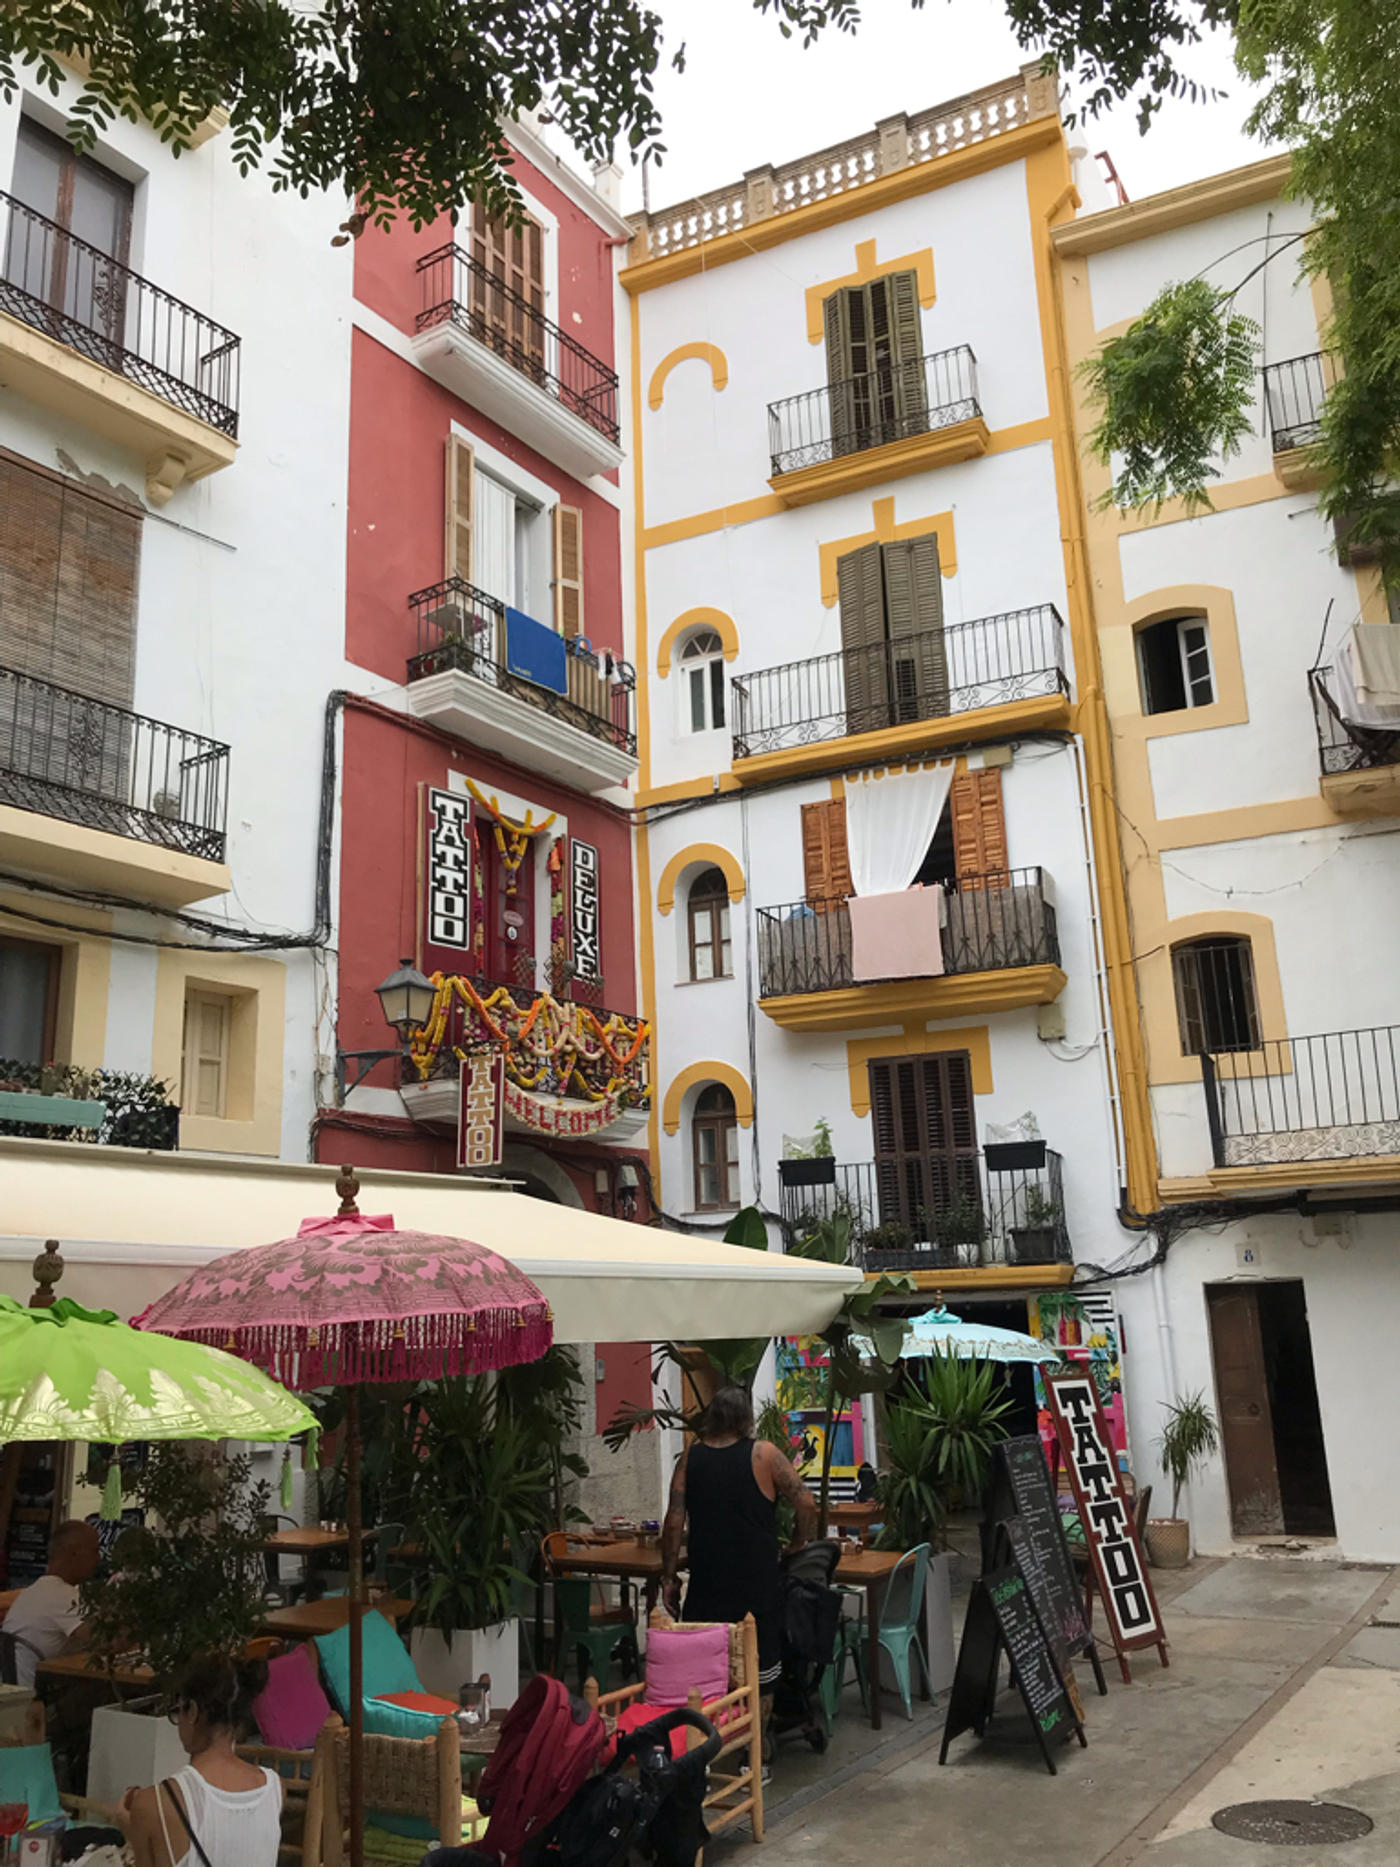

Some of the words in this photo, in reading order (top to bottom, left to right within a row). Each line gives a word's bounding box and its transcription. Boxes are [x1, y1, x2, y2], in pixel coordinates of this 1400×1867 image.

[432, 794, 468, 945] TATTOO
[574, 846, 597, 978] DELUXE
[468, 1056, 494, 1165] TATTOO
[504, 1080, 616, 1134] WELCOME
[1244, 1249, 1254, 1263] 8
[1058, 1386, 1153, 1630] TATTOO
